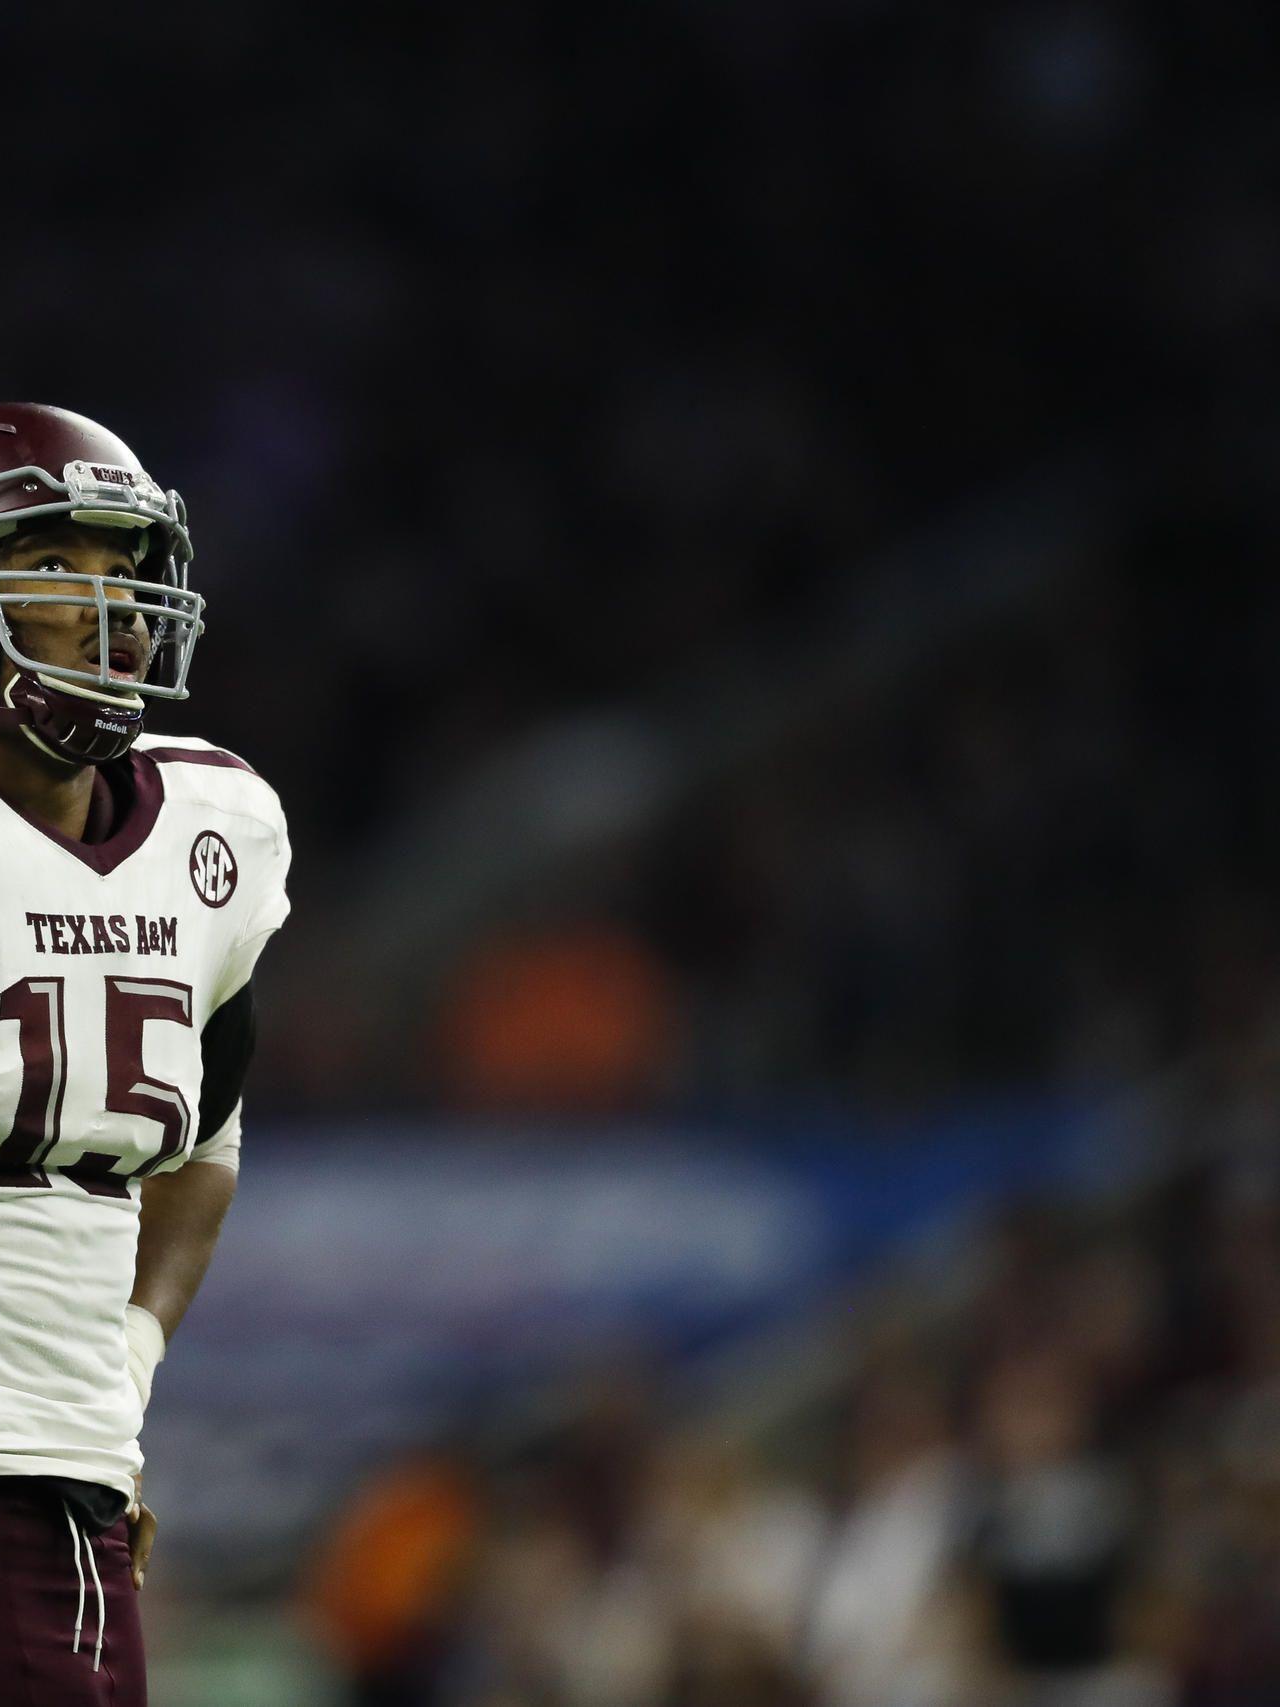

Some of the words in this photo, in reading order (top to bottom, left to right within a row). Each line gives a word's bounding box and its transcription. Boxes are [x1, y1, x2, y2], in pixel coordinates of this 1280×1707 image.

[95, 719, 128, 734] Riddell
[194, 836, 234, 902] SEC
[25, 912, 131, 954] TEXAS
[136, 915, 178, 956] A&M
